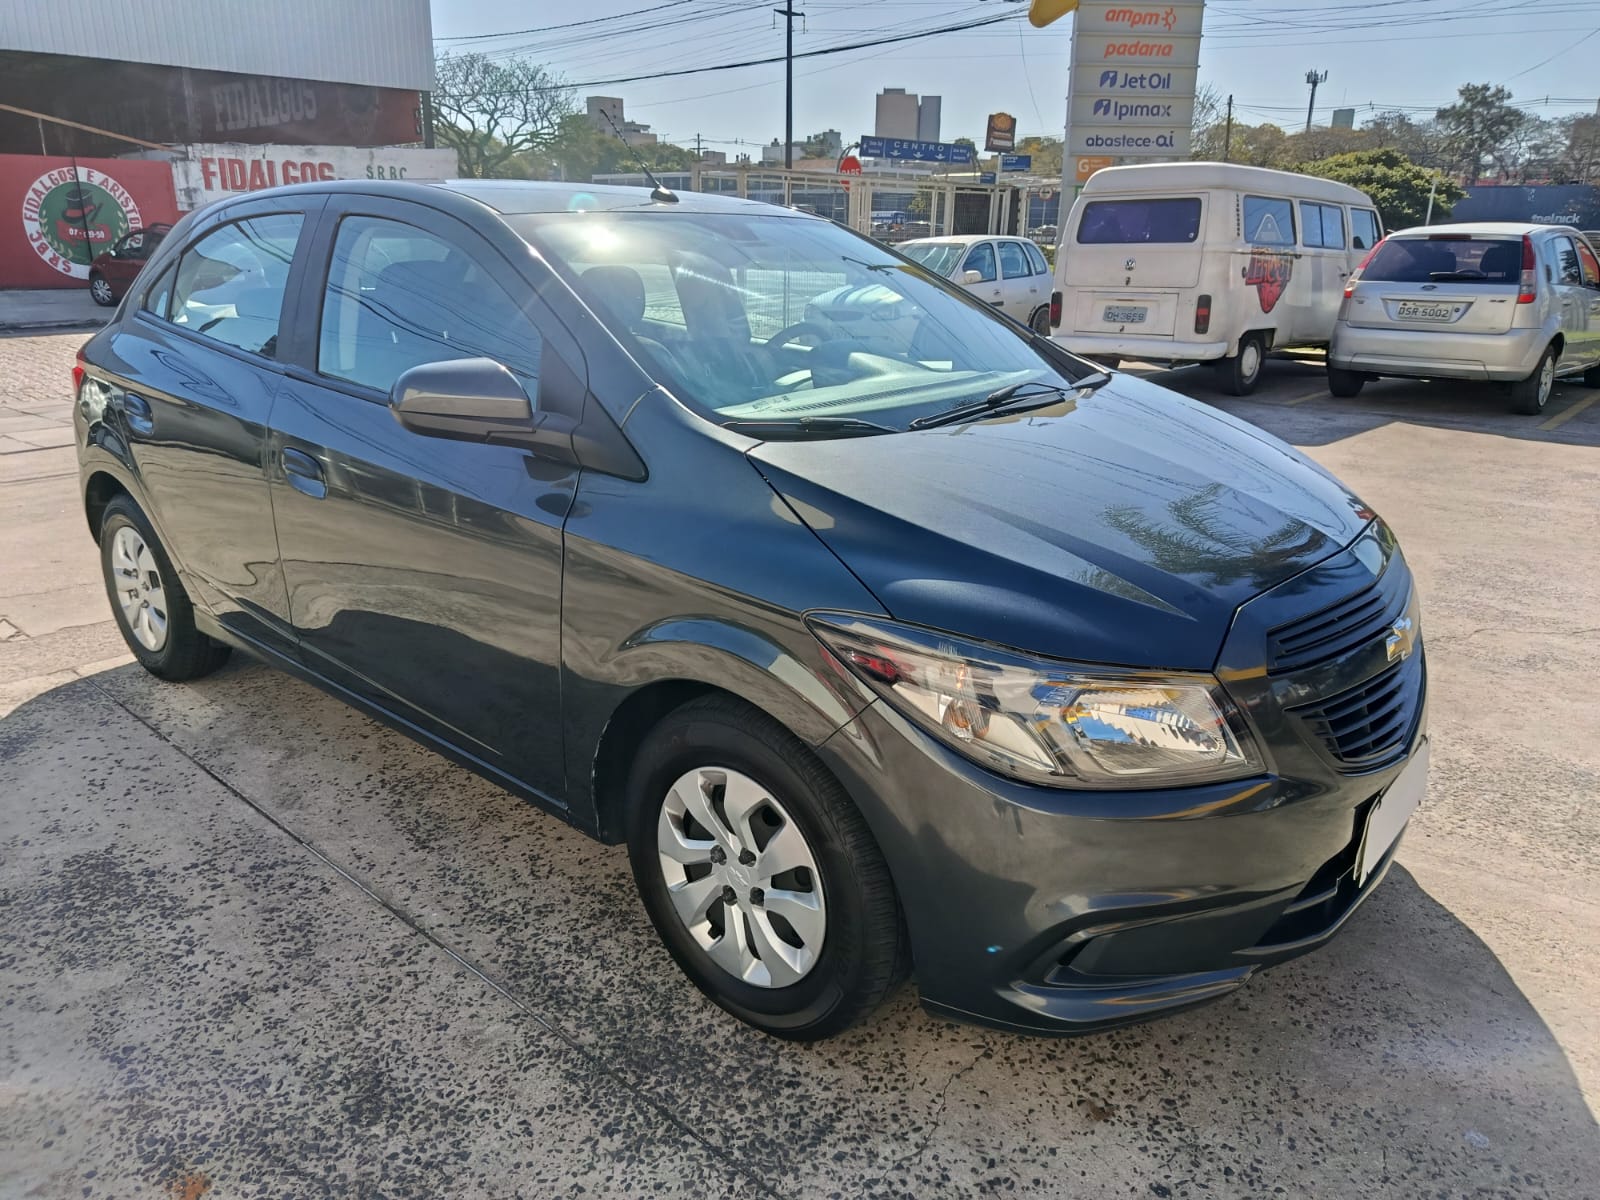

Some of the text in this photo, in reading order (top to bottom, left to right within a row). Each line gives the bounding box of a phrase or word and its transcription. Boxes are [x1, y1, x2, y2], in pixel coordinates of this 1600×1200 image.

[1105, 8, 1160, 28] ampm
[1104, 40, 1173, 59] padaria
[213, 80, 318, 132] FIDALGOS
[1114, 101, 1172, 120] Ipimax
[894, 141, 945, 152] CENTRO
[24, 168, 77, 222] FIDALGOS
[86, 170, 95, 183] E
